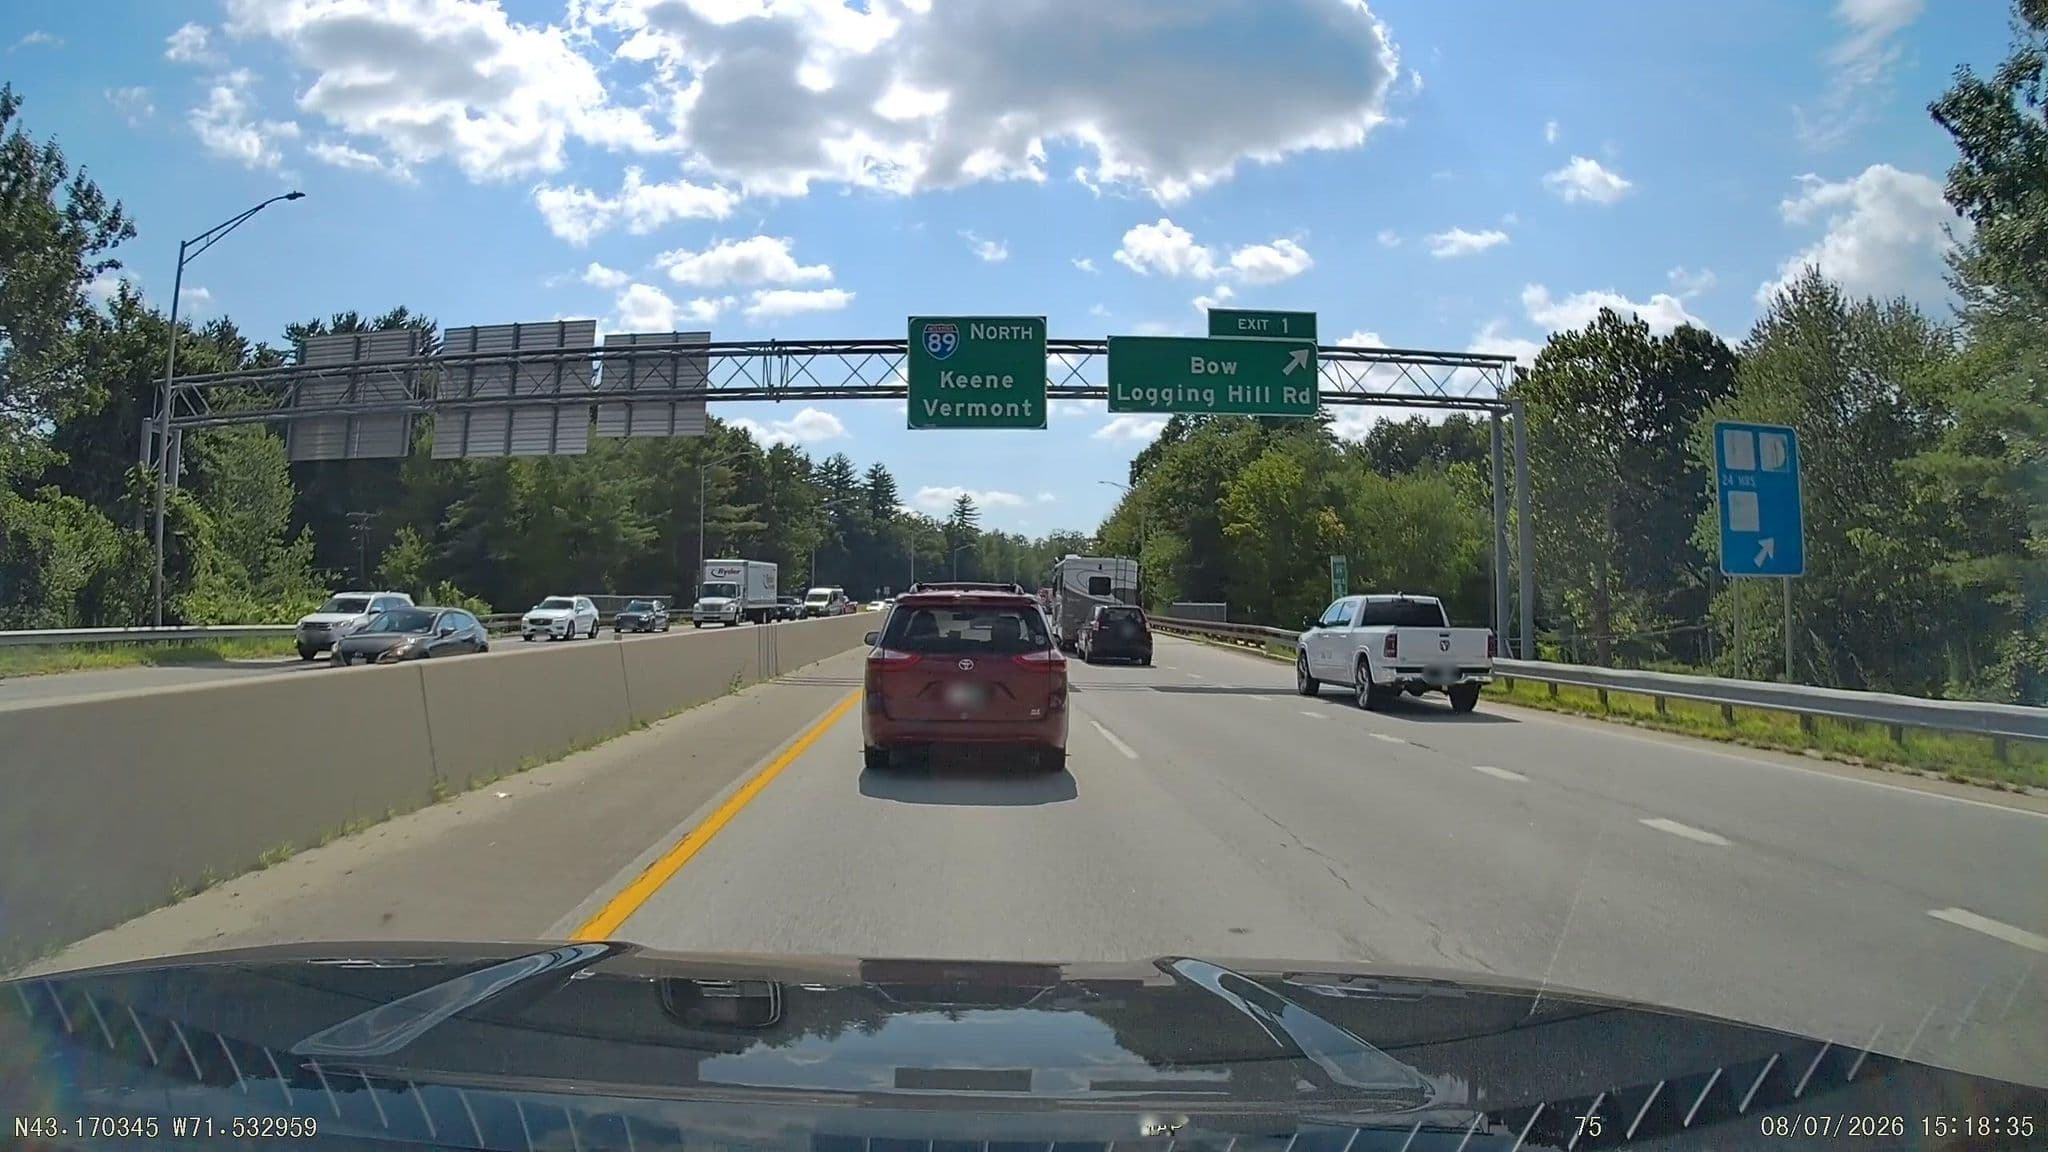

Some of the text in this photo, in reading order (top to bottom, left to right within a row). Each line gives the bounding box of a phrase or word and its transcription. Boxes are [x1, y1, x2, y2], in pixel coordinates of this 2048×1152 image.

[970, 323, 1033, 340] NORTH
[1238, 318, 1289, 334] EXIT 1
[928, 333, 956, 353] 89
[1191, 356, 1237, 375] Bow
[940, 371, 1014, 389] Keene
[1117, 384, 1310, 407] Logging Hill Rd
[923, 399, 1032, 417] Vermont
[1722, 474, 1734, 487] 24
[718, 568, 741, 576] Ryder
